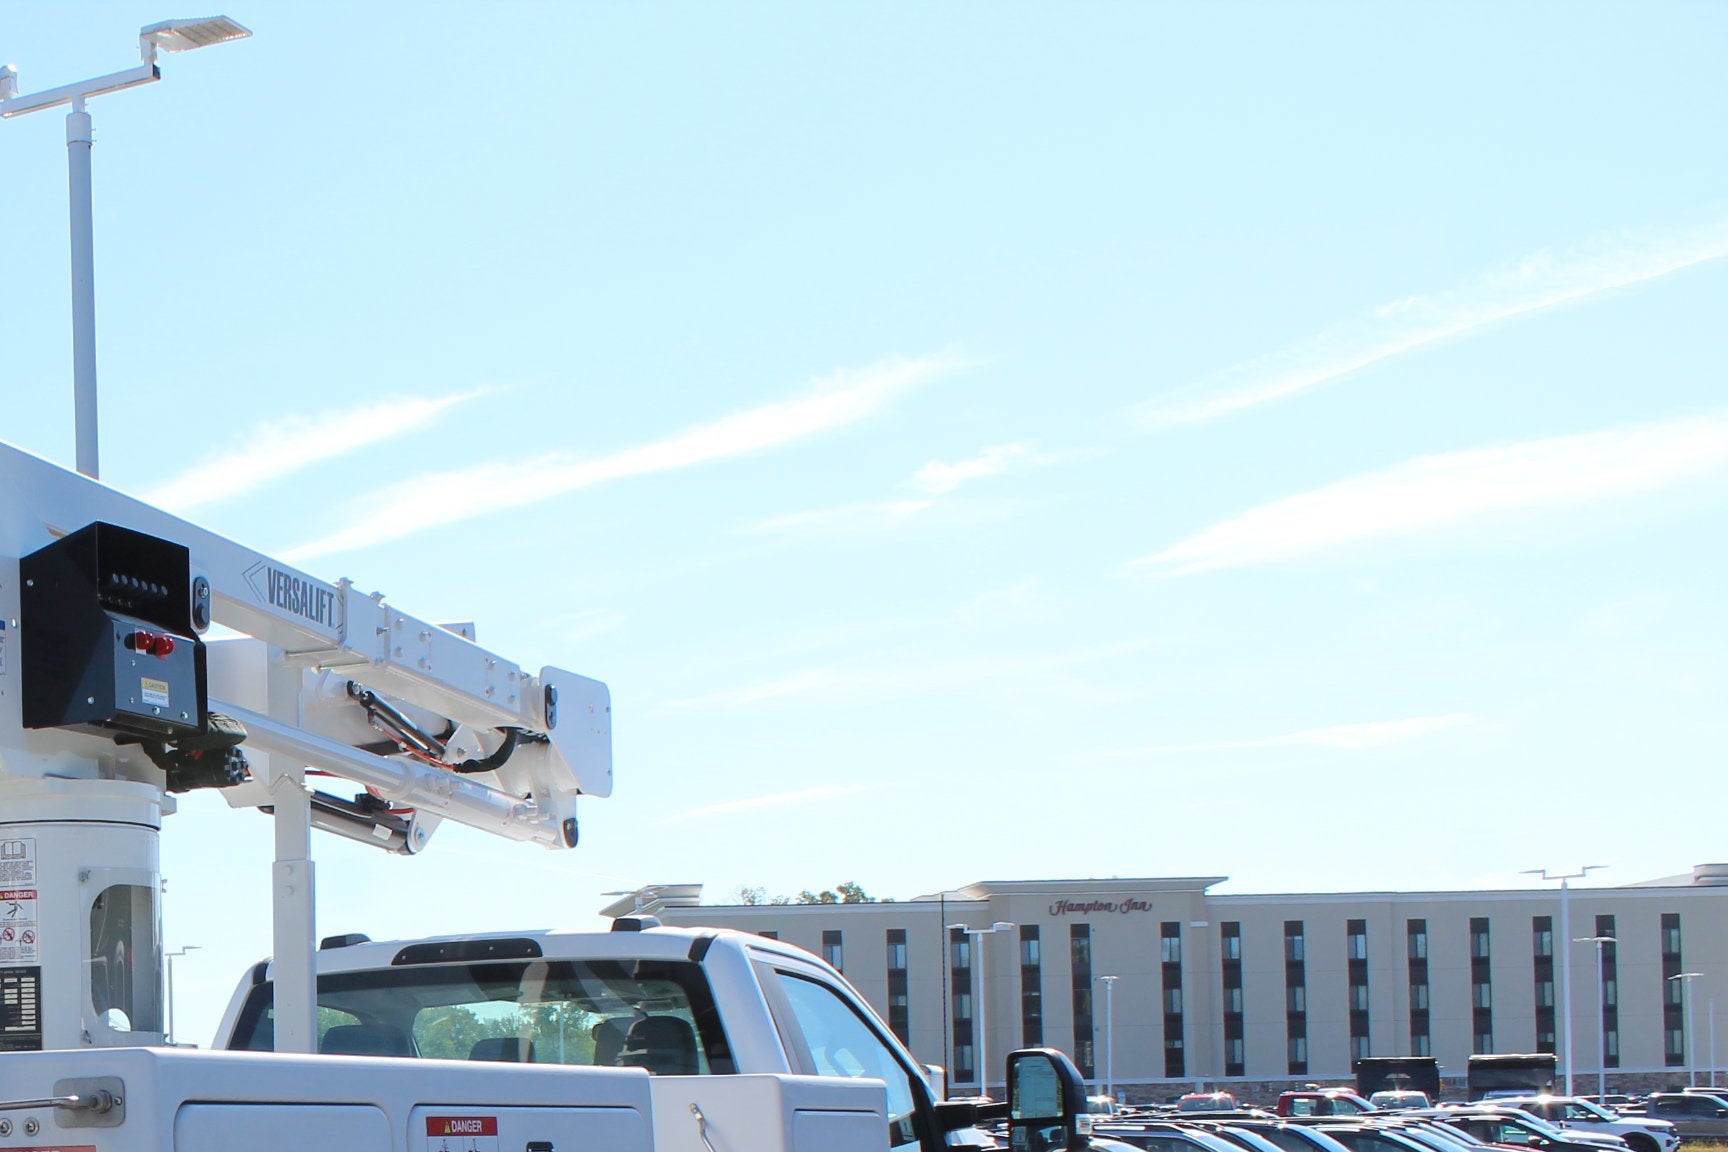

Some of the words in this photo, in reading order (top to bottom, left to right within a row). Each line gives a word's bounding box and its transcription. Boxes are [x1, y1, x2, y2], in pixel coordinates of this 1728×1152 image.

[267, 567, 334, 627] VERSALIFT
[4, 891, 33, 899] DANGER
[1049, 899, 1118, 916] Hampton
[1119, 898, 1152, 914] Inn
[451, 1120, 482, 1132] DANGER
